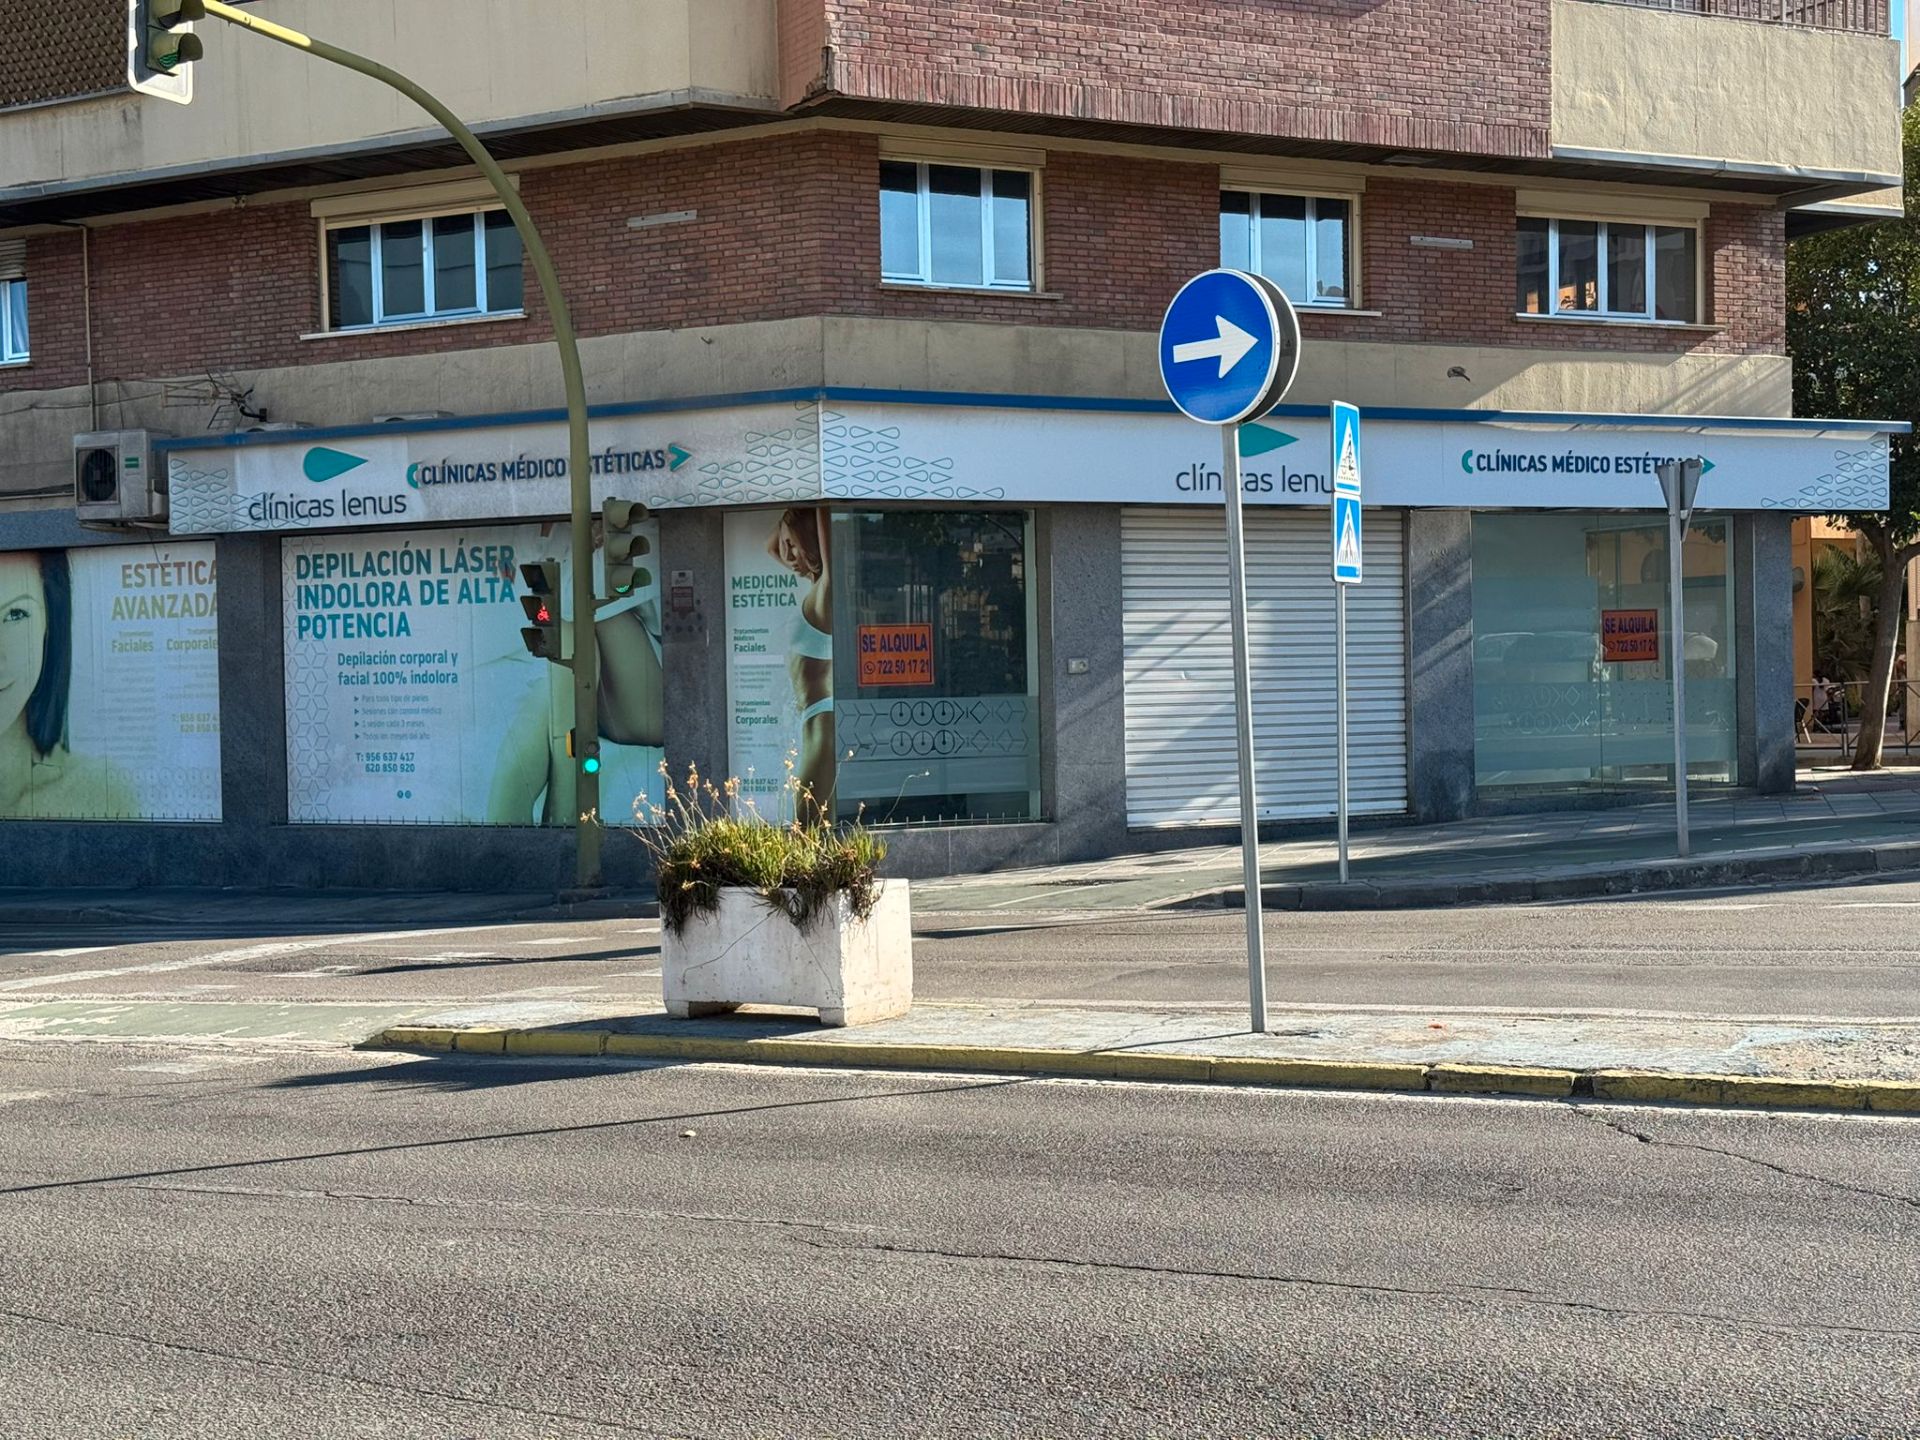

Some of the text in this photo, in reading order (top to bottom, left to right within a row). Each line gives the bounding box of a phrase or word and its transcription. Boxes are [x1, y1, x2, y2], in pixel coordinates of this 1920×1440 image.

[421, 447, 666, 485] CLÍNICAS MÉDICO TÉTICAS
[1476, 449, 1548, 472] CLÍNICAS
[1552, 450, 1610, 473] MÉDICO
[1176, 463, 1334, 494] clínas lenu
[249, 489, 407, 521] clínicas lenus
[296, 538, 515, 580] DEPILACIÓN LÁSER
[731, 574, 798, 590] MEDICINA
[297, 577, 516, 610] INDOLORA DE ALTA
[732, 589, 797, 608] ESTÉTICA
[297, 611, 411, 640] POTENCIA
[1605, 617, 1654, 634] SE ALQUILA
[111, 639, 154, 654] Faciales
[165, 636, 218, 654] Corporale
[734, 643, 766, 652] Faciales
[862, 633, 928, 653] SE ALQUILA
[337, 649, 459, 669] Depilación corporal y
[877, 659, 930, 675] 722 50 17 21
[337, 669, 459, 685] facial 100% indolora
[735, 715, 778, 726] Corporales
[356, 752, 415, 762] T: 956 637 417
[365, 763, 415, 772] 620 850 920
